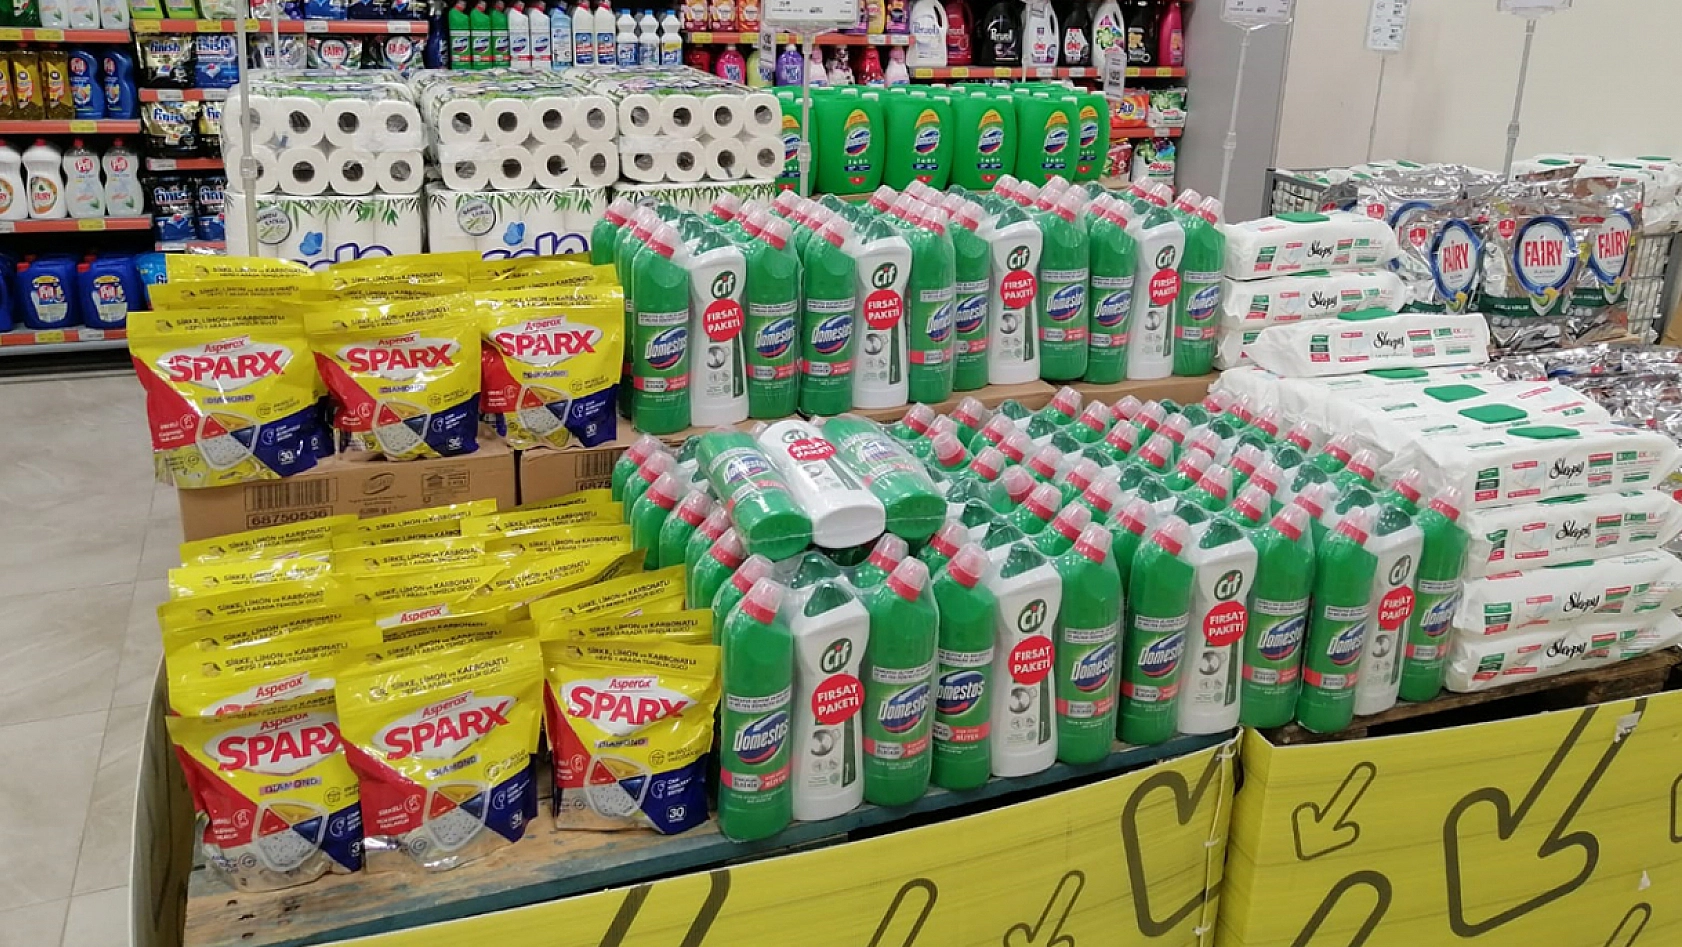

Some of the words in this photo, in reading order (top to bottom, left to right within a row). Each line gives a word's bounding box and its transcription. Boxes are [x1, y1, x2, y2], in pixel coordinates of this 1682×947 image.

[1524, 235, 1563, 268] FAIRY
[1597, 227, 1630, 259] FAIRY
[1007, 248, 1030, 269] Cif
[1156, 248, 1175, 269] Cif
[1443, 240, 1469, 274] FAIRY
[713, 274, 735, 297] Cif
[873, 266, 896, 288] Cif
[1003, 278, 1033, 290] FIRSAT
[707, 307, 739, 322] FIRSAT
[868, 297, 899, 310] FIRSAT
[525, 318, 562, 332] Asperox
[707, 317, 741, 334] PAKETİ
[204, 338, 246, 354] Asperox
[378, 335, 416, 347] Asperox
[495, 329, 596, 357] SPARX
[1373, 330, 1406, 350] Sleepy
[169, 350, 285, 382] SPARX
[346, 344, 455, 372] SPARX
[1549, 457, 1585, 480] Sleepy
[1555, 519, 1592, 542] Sleepy
[1217, 573, 1243, 598] Cif
[1563, 591, 1600, 613] Sleepy
[400, 607, 442, 624] Asperox
[1020, 602, 1045, 630] Cif
[1209, 611, 1245, 625] FIRSAT
[1208, 621, 1245, 637] PAKETİ
[822, 642, 851, 671] Cif
[1014, 646, 1051, 661] FIRSAT
[1546, 638, 1588, 660] Sleepy
[1013, 660, 1051, 675] PAKETİ
[255, 676, 304, 698] Asperox
[608, 678, 653, 693] Asperox
[817, 684, 858, 703] FIRSAT
[422, 695, 468, 718] Asperox
[567, 685, 689, 726] SPARX
[817, 696, 859, 717] PAKETİ
[259, 712, 309, 732] Asperox
[383, 700, 511, 760] SPARX
[217, 721, 342, 771] SPARX
[732, 718, 790, 752] Domestos
[668, 806, 685, 819] 30
